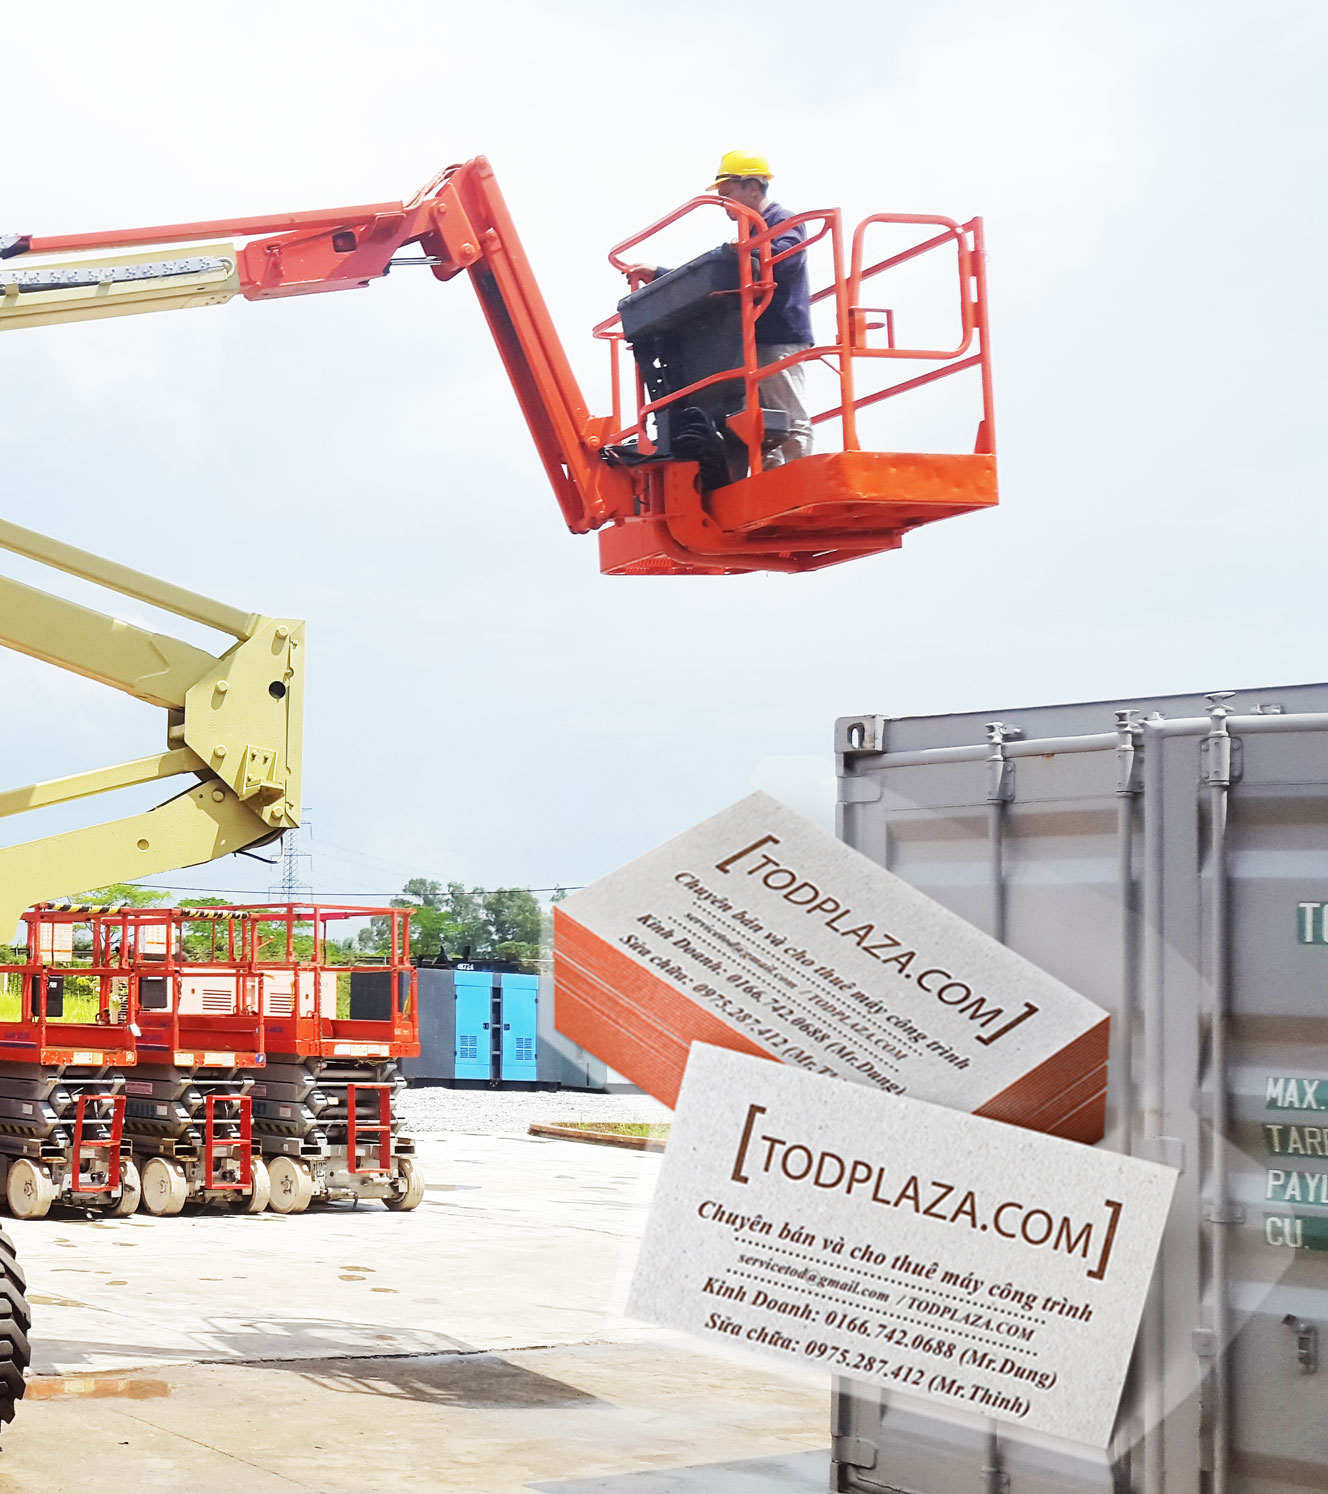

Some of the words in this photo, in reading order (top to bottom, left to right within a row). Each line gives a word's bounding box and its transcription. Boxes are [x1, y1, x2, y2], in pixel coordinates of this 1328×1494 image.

[1298, 902, 1328, 943] T
[1266, 1077, 1326, 1110] MAX.
[1265, 1216, 1309, 1249] CU.
